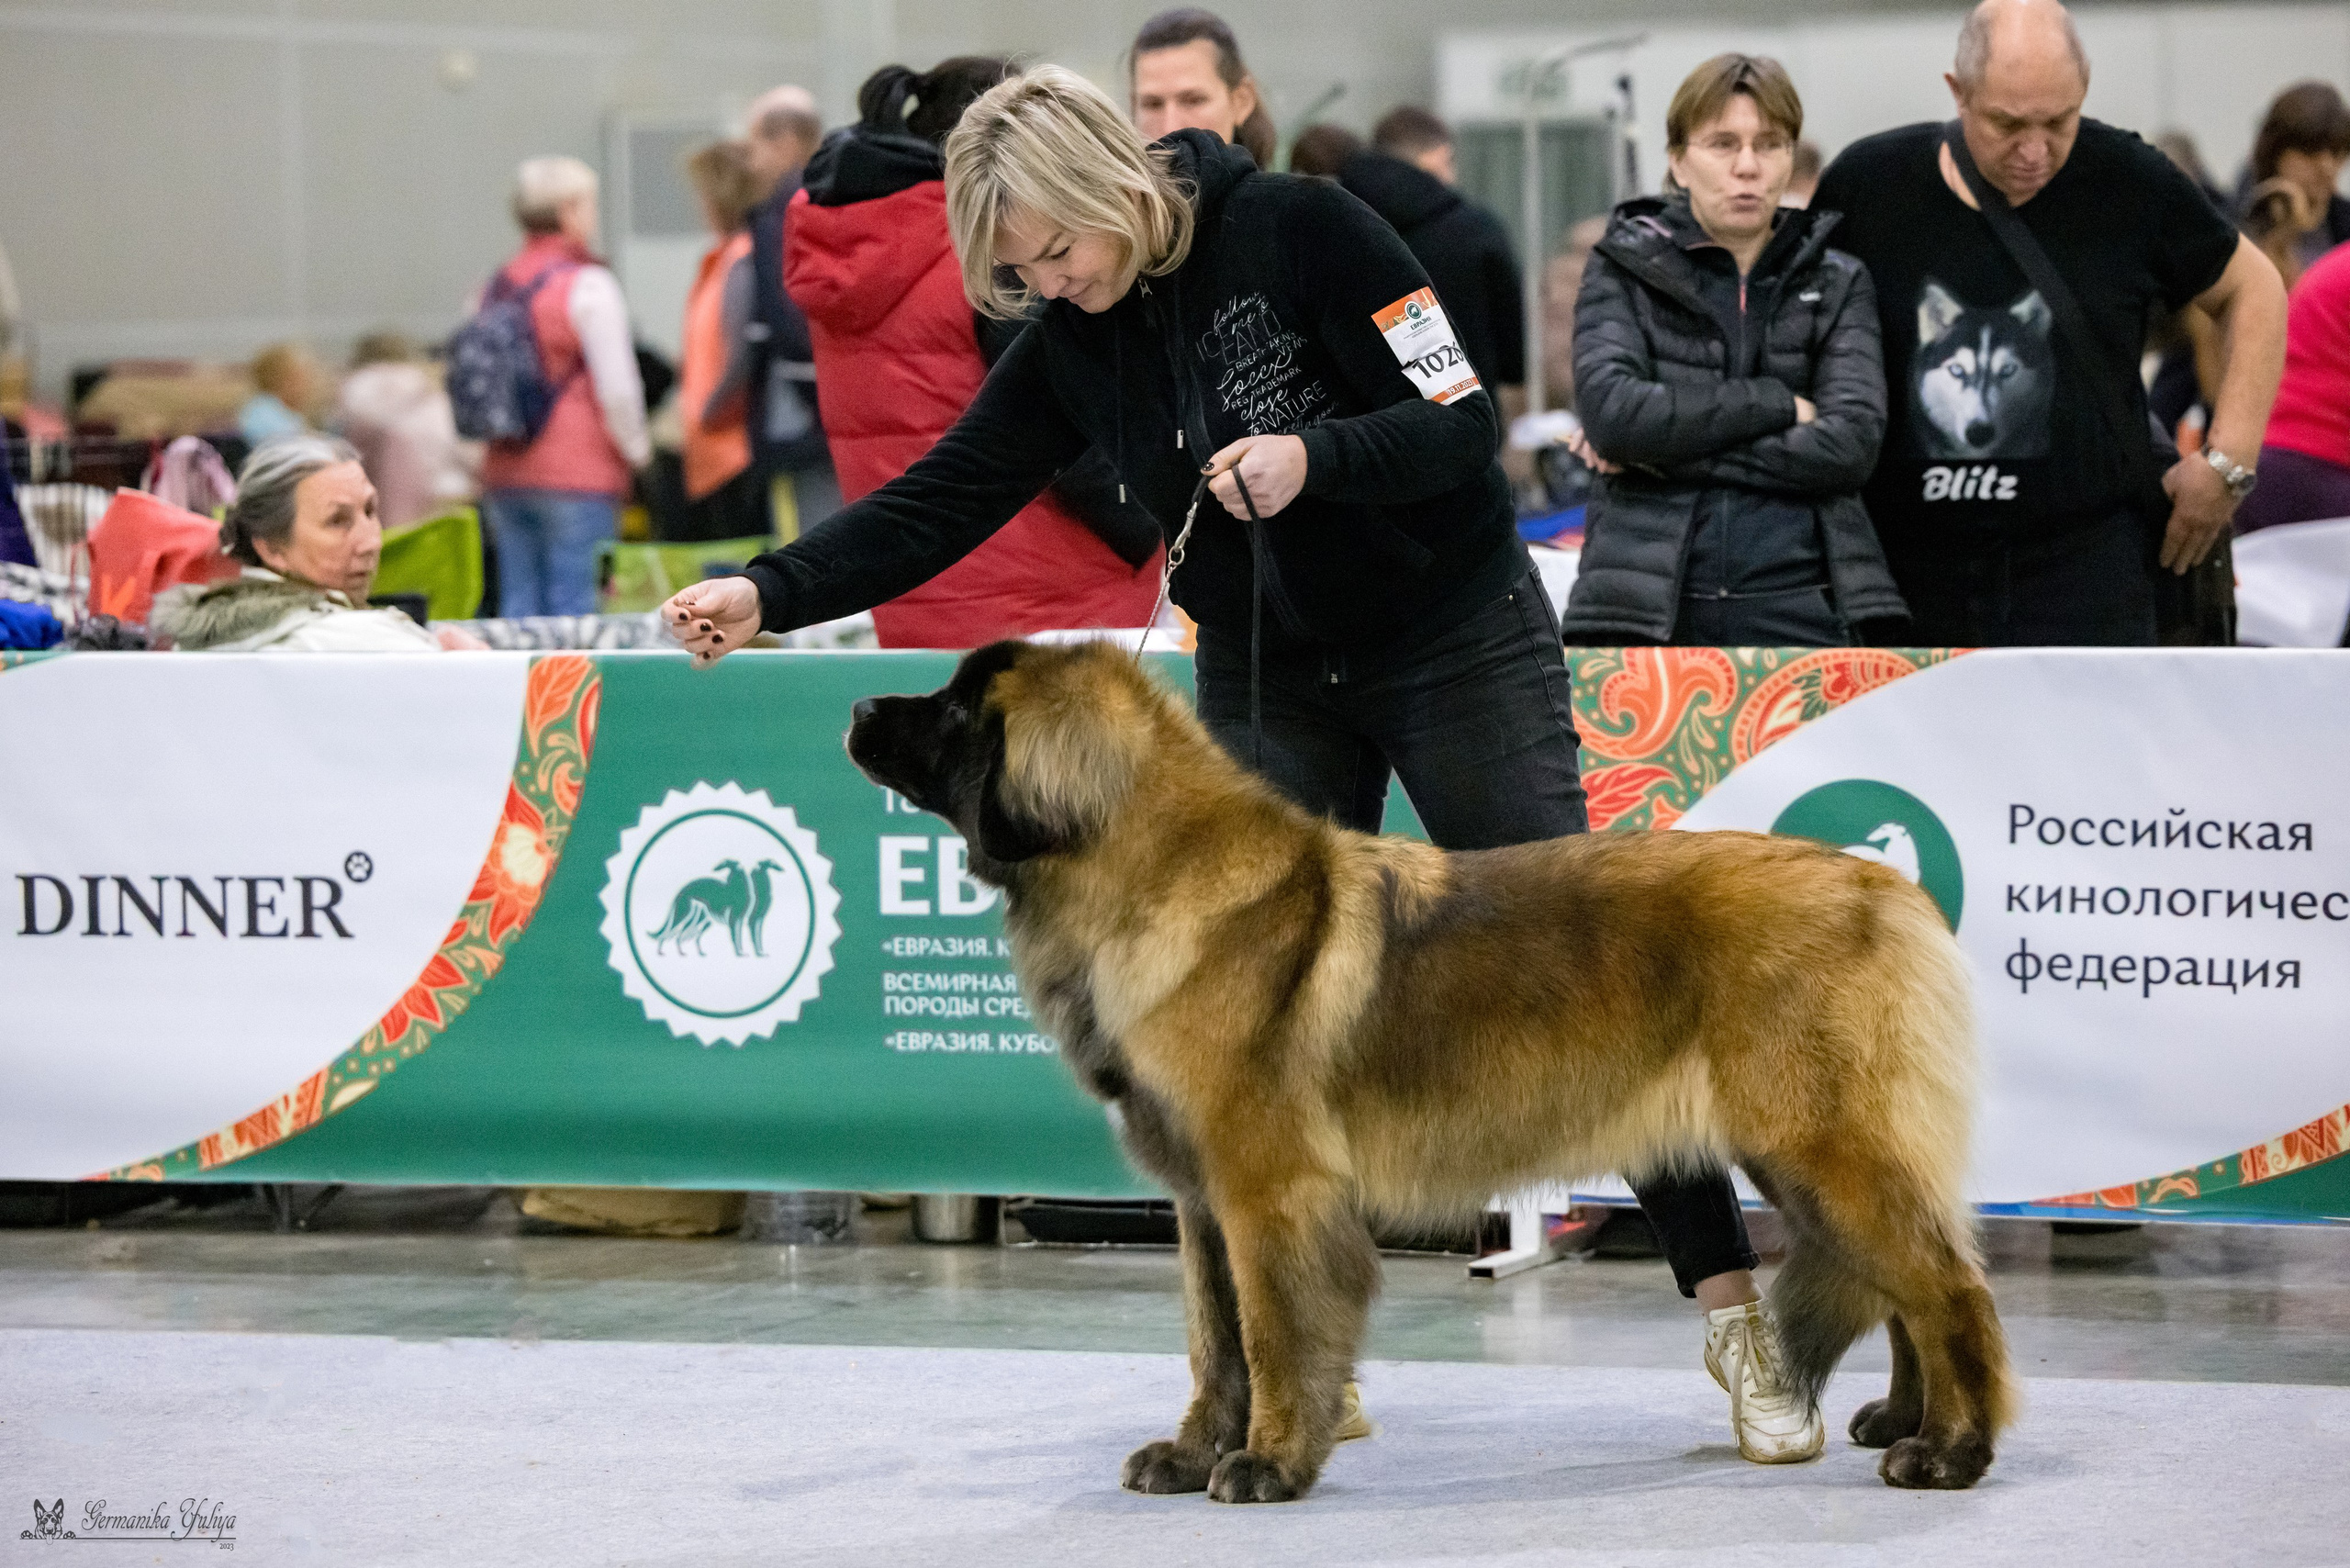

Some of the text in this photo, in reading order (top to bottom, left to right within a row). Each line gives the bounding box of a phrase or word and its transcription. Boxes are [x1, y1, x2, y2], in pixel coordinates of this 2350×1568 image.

[1240, 388, 1288, 420] close
[1260, 380, 1327, 431] NATURE
[1922, 465, 2019, 501] Blitz
[2008, 803, 2313, 852] Российская
[15, 873, 355, 938] DINNER
[2005, 883, 2350, 921] кинологичес
[882, 971, 1017, 992] ВСЕМИРНАЯ
[2005, 937, 2301, 999] федерация
[884, 995, 979, 1018] ПОРОДЫ
